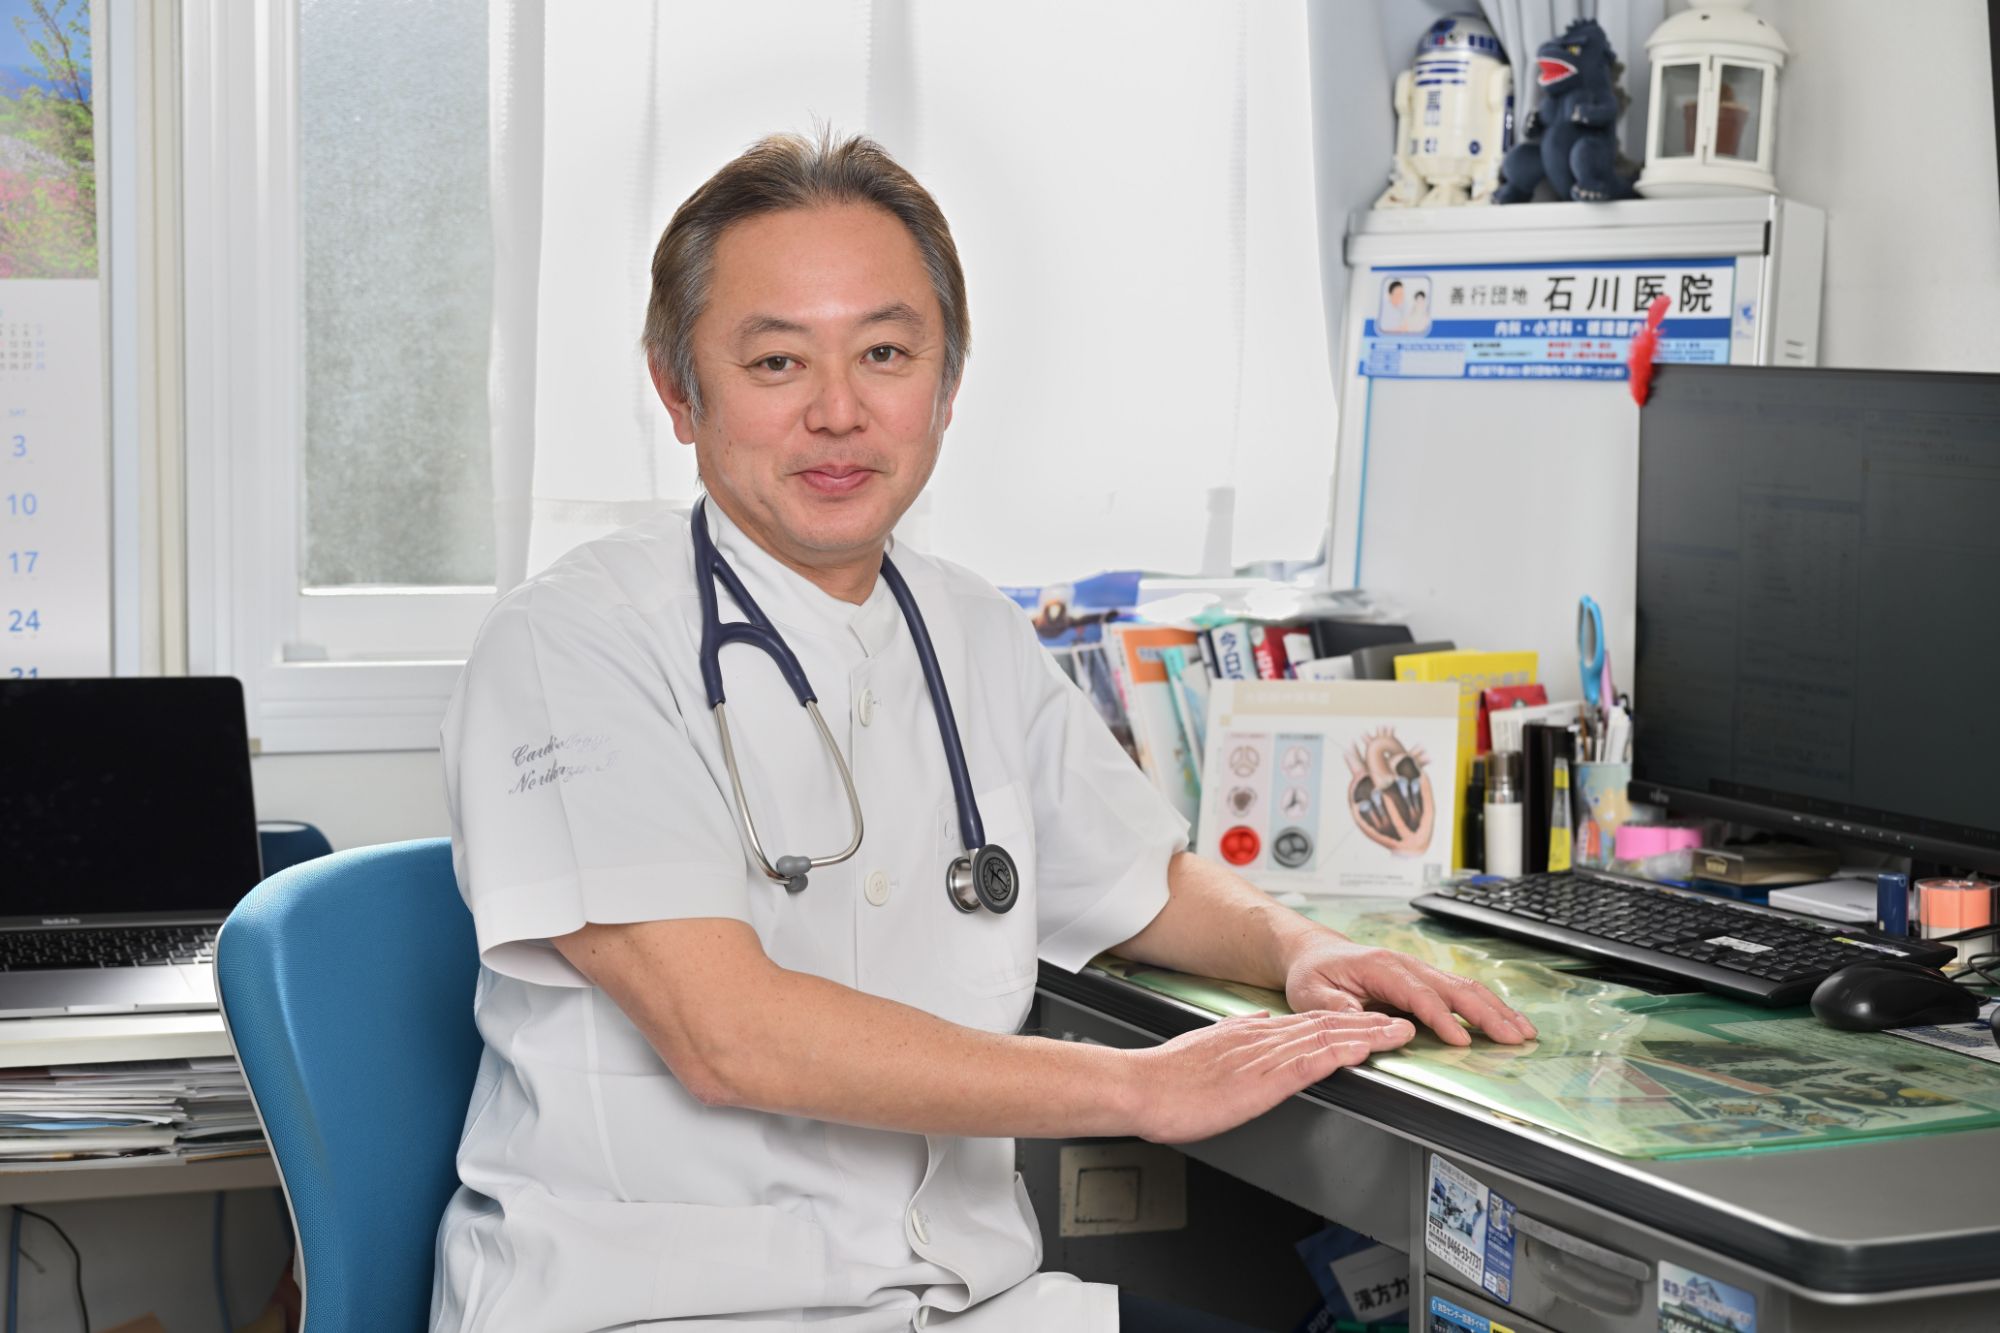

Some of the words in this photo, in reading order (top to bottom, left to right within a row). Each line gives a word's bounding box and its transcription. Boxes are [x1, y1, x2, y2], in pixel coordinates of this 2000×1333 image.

[1544, 274, 1714, 314] 石川医院
[12, 434, 27, 457] 3
[7, 492, 37, 515] 10
[9, 551, 39, 574] 17
[8, 609, 41, 632] 24
[1219, 631, 1246, 680] 今日
